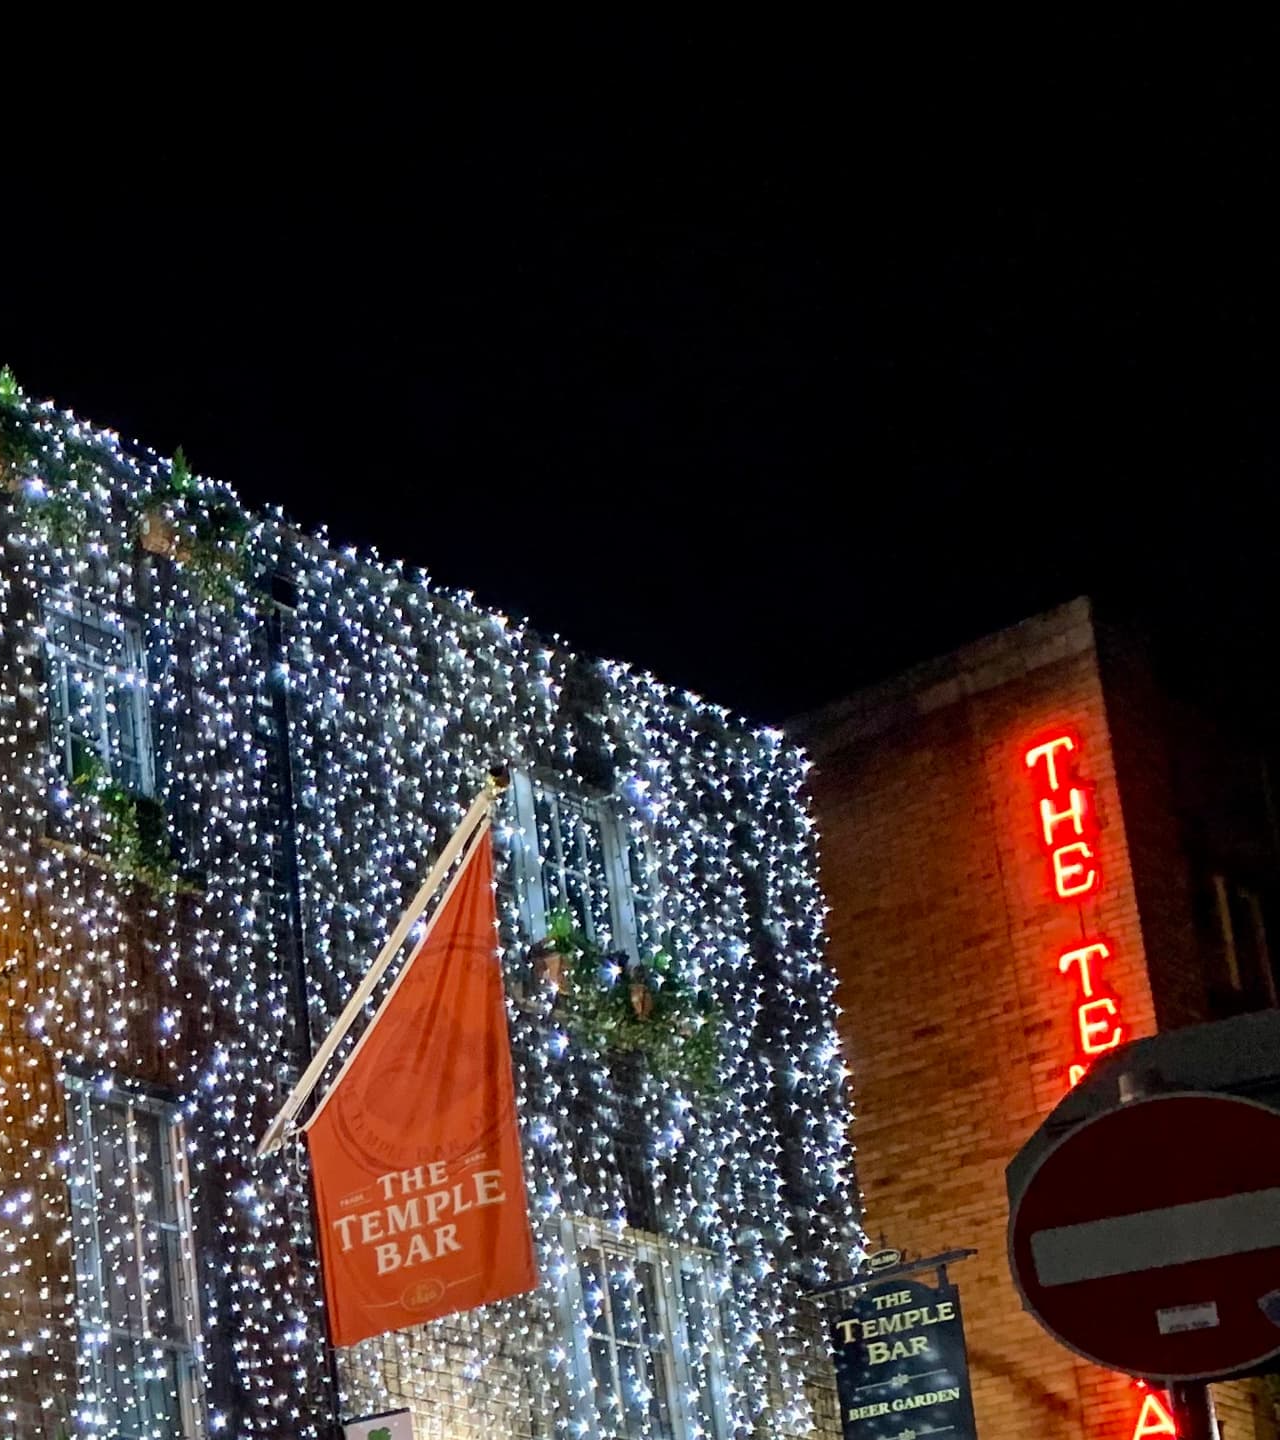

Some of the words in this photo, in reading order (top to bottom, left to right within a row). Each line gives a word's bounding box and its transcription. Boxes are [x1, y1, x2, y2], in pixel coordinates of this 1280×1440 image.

[1025, 736, 1096, 897] THE
[377, 1161, 449, 1200] THE
[333, 1169, 508, 1252] TEMPLE
[374, 1223, 462, 1276] BAR
[872, 1290, 912, 1311] THE
[836, 1302, 956, 1344] TEMPLE
[867, 1335, 929, 1366] BAR
[849, 1402, 890, 1421] BEER
[892, 1387, 960, 1413] GARDEN
